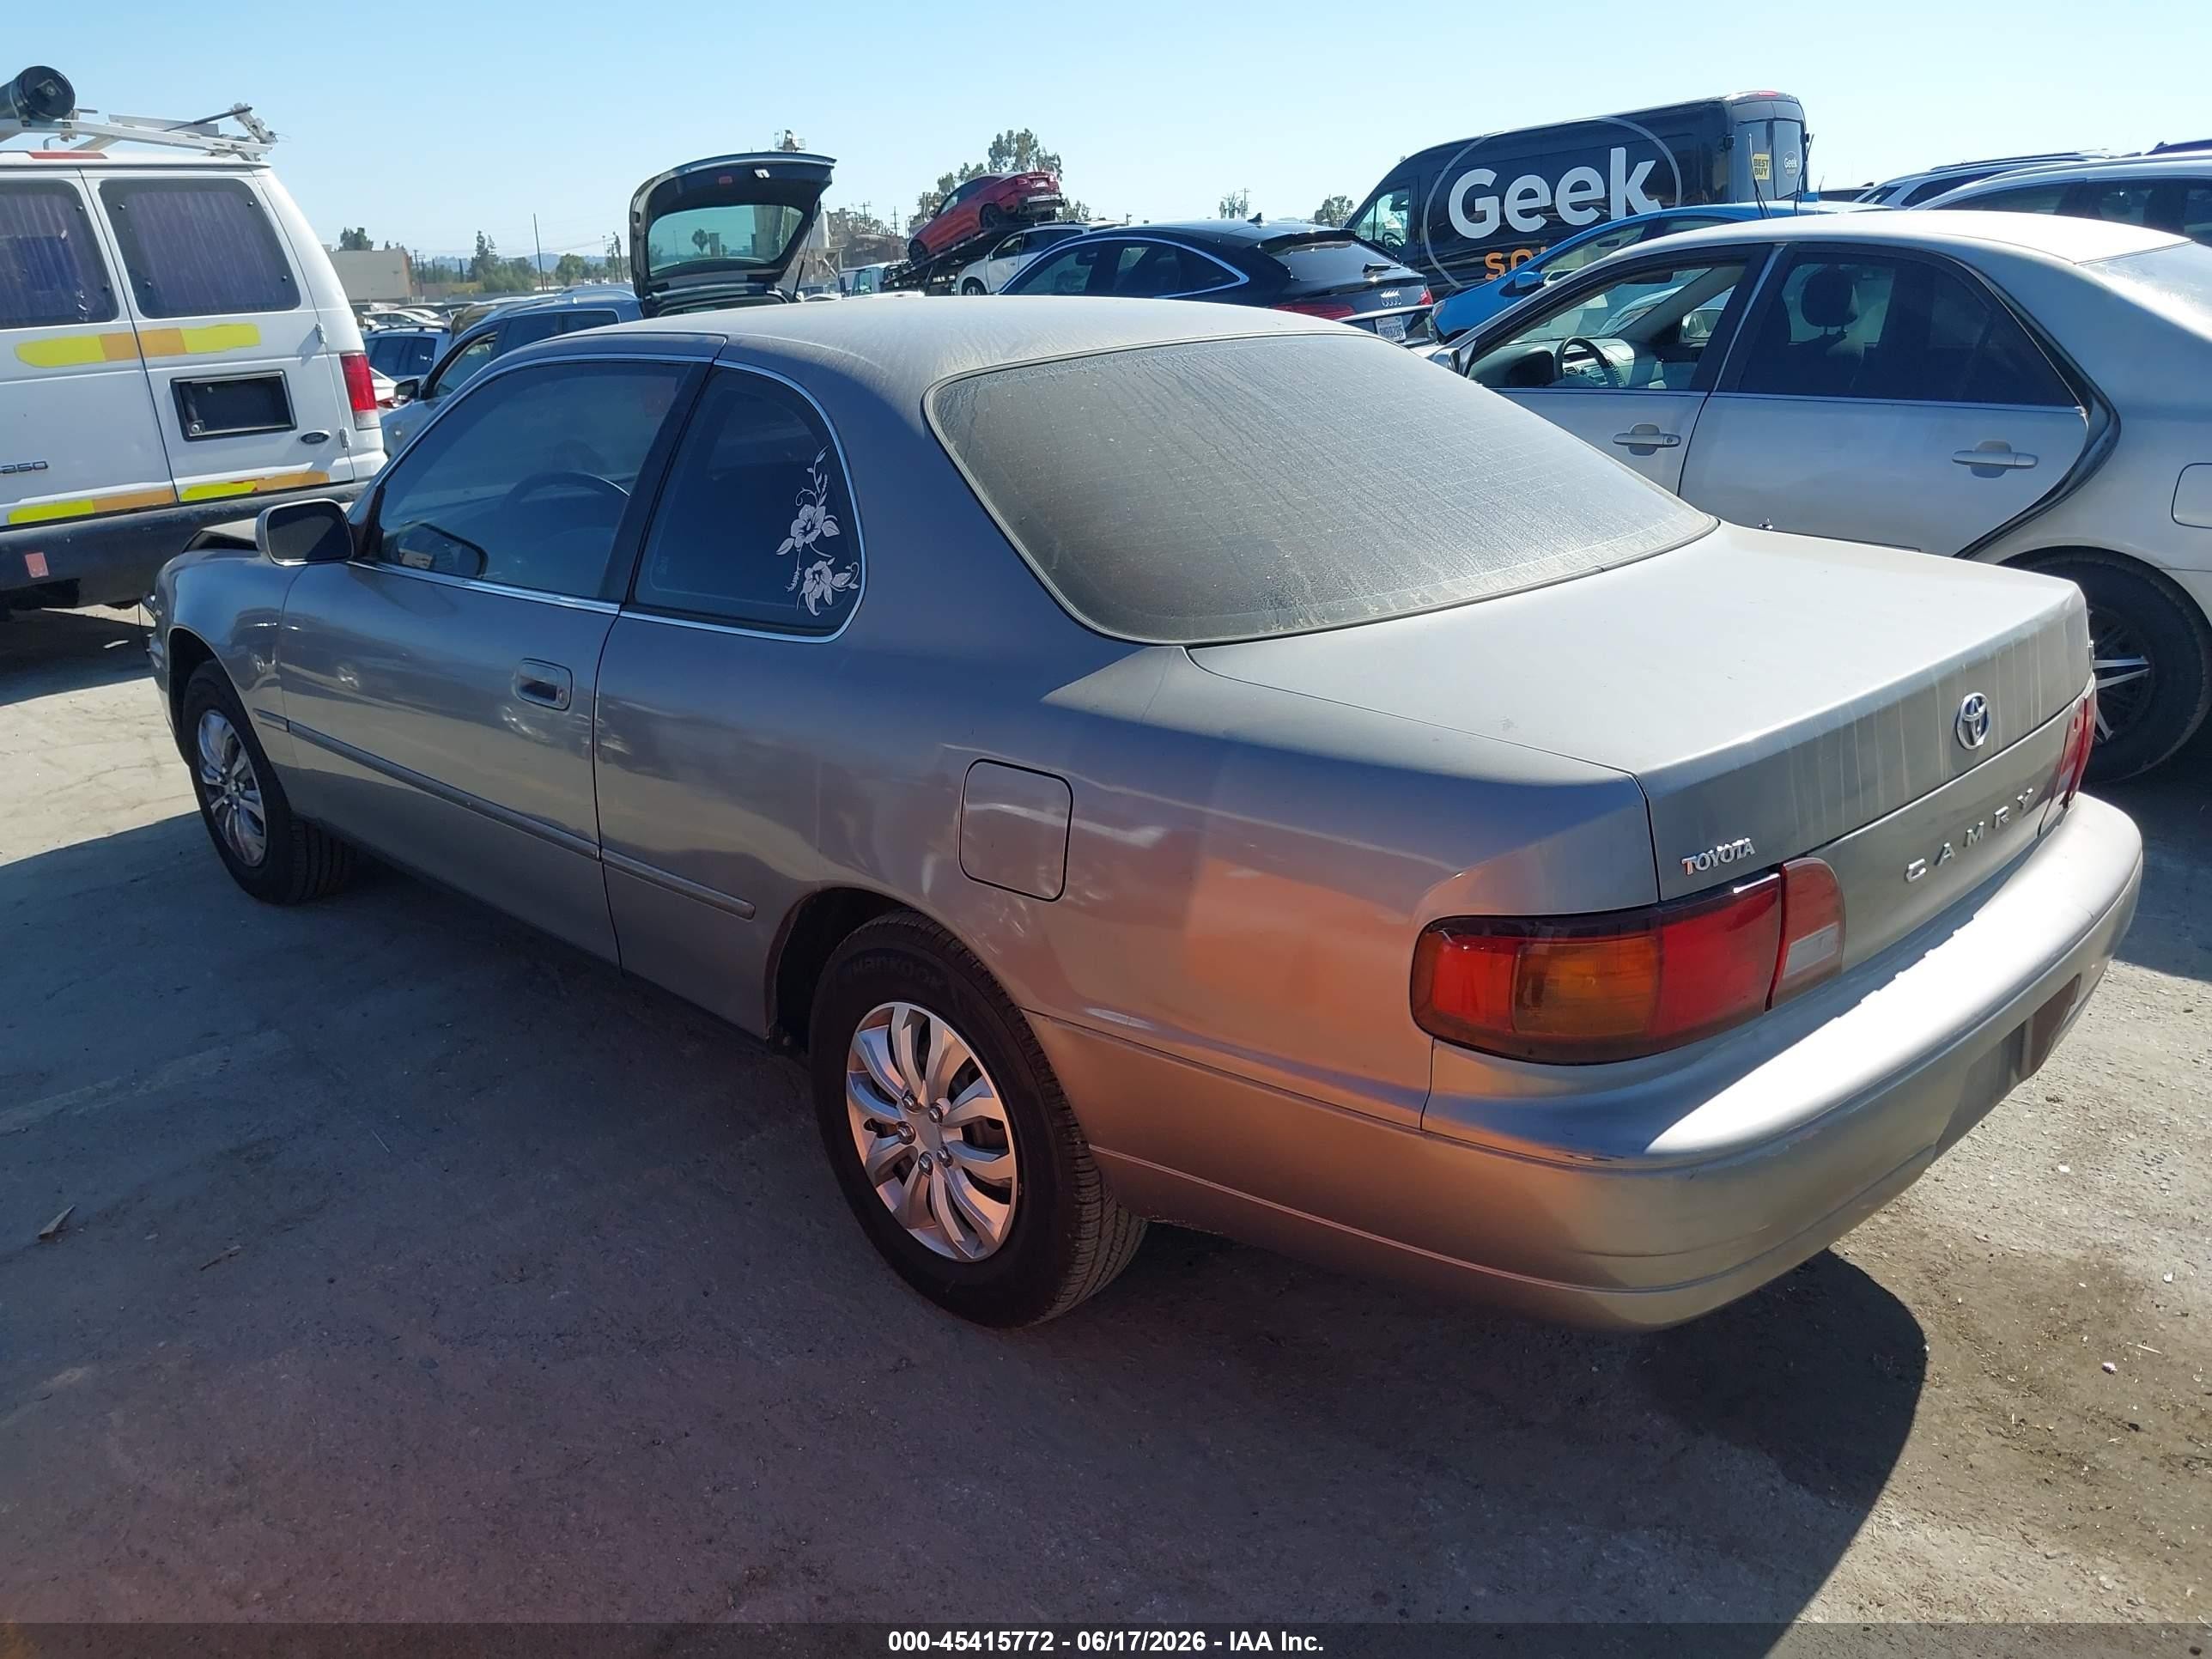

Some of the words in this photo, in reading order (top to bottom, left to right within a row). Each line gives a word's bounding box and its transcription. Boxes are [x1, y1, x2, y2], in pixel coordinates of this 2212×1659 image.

[1753, 158, 1769, 167] BEST
[1754, 167, 1767, 176] BUY
[1449, 147, 1662, 239] Geek
[1905, 787, 2033, 883] CAMRY
[1681, 837, 1755, 875] TOYOTA
